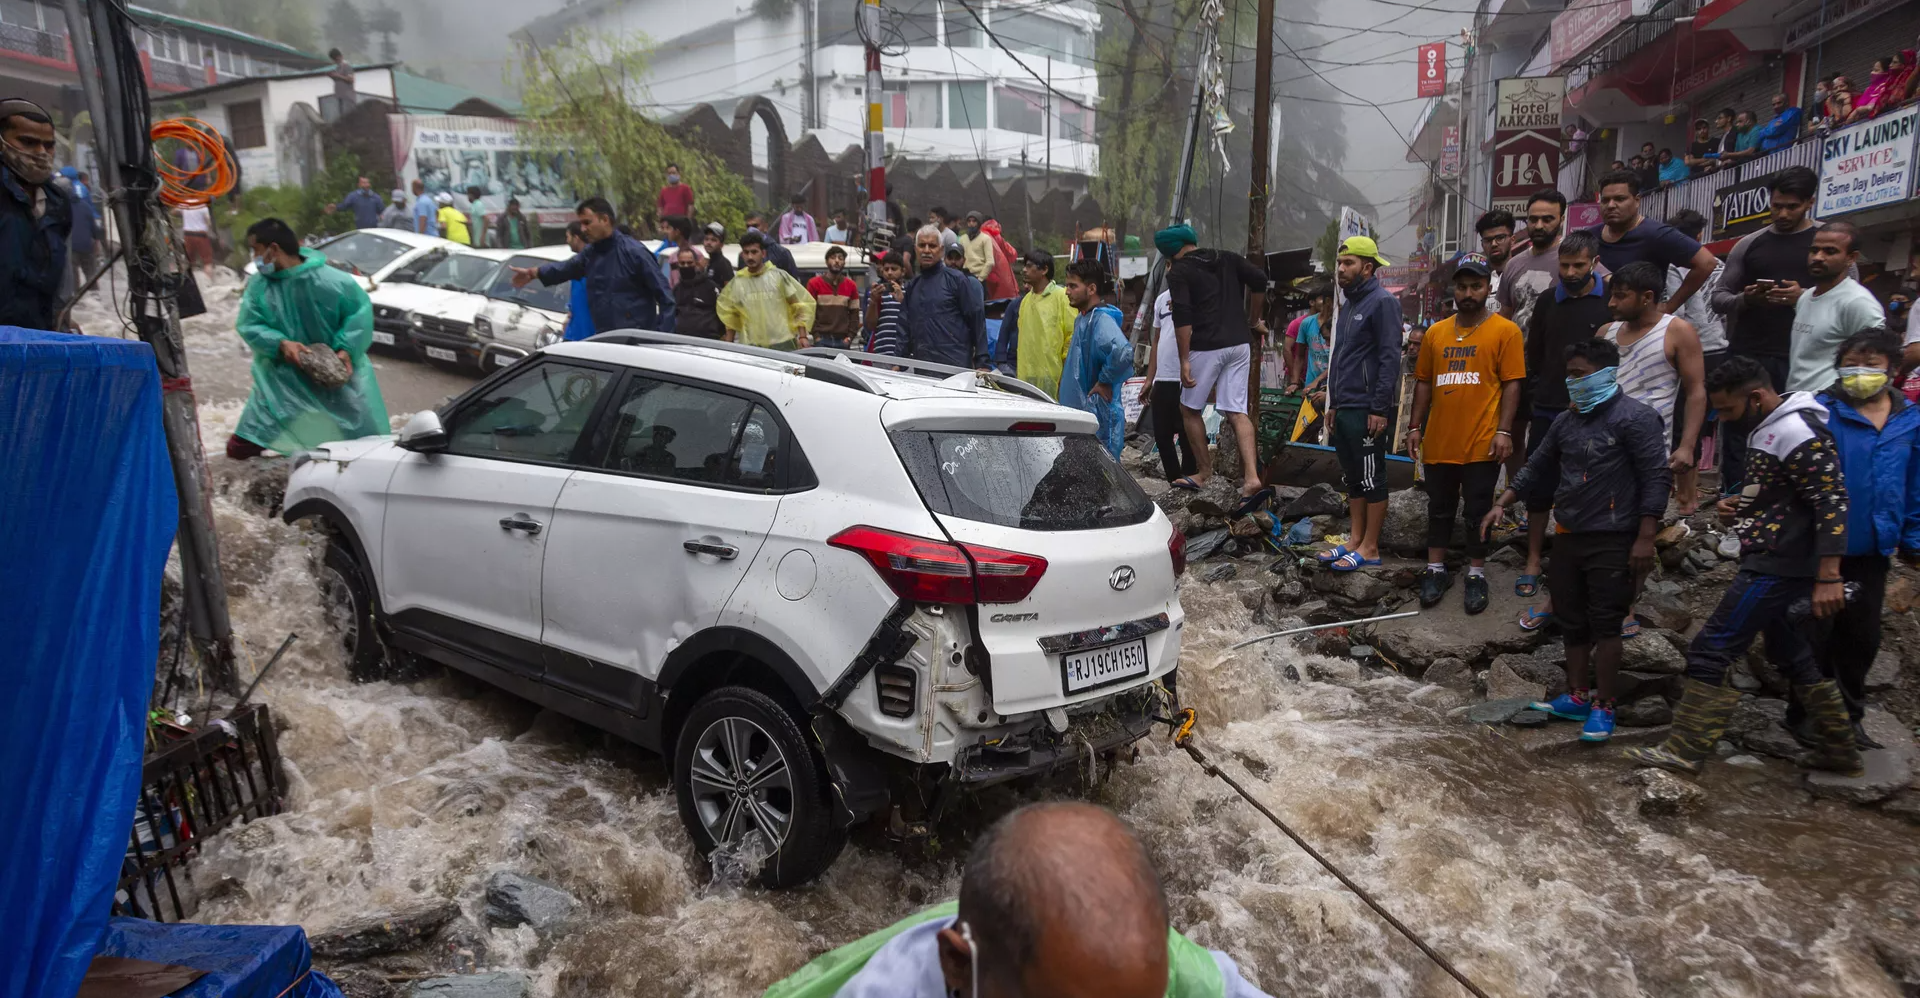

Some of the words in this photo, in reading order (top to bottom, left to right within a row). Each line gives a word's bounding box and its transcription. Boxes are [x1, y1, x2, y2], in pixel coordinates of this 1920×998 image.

[1427, 49, 1437, 78] OYO
[1675, 67, 1710, 95] STREET
[1712, 52, 1740, 77] CAFE
[1511, 102, 1549, 115] Hotel
[1499, 114, 1559, 127] AAKARSH
[1824, 134, 1850, 160] SKY
[1854, 112, 1918, 152] LAUNDRY
[1836, 147, 1893, 175] SERVICE
[1827, 183, 1850, 197] Same
[1853, 177, 1868, 192] Day
[1871, 171, 1904, 188] Delivery
[1722, 186, 1771, 230] TATTO
[1458, 252, 1487, 267] VANS
[1443, 345, 1477, 359] STRIVE
[1448, 360, 1466, 372] FOR
[1436, 372, 1481, 387] REATNESS.
[990, 612, 1039, 623] CRETA
[1075, 645, 1143, 681] RJ19CH1550
